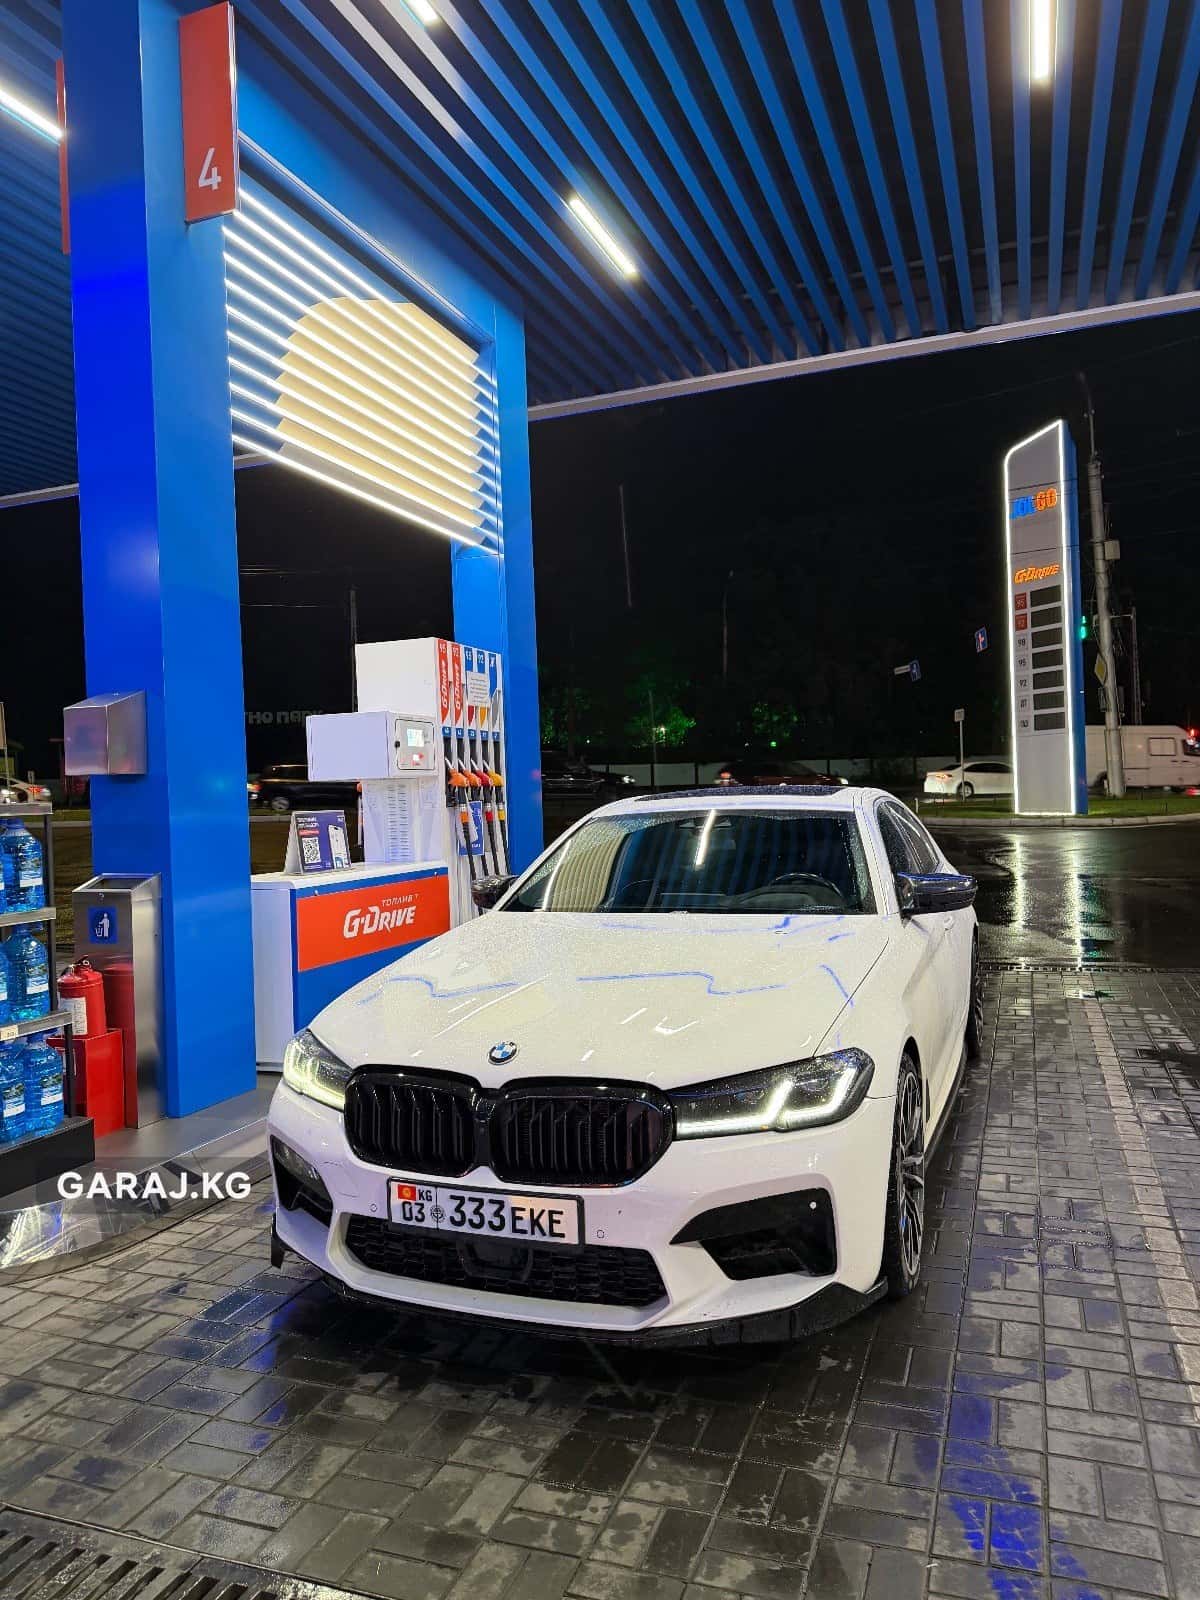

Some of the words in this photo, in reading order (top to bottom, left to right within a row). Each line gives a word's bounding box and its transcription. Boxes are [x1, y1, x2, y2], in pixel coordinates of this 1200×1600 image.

[198, 147, 222, 190] 4
[418, 1189, 433, 1201] KG
[402, 1200, 425, 1222] 03
